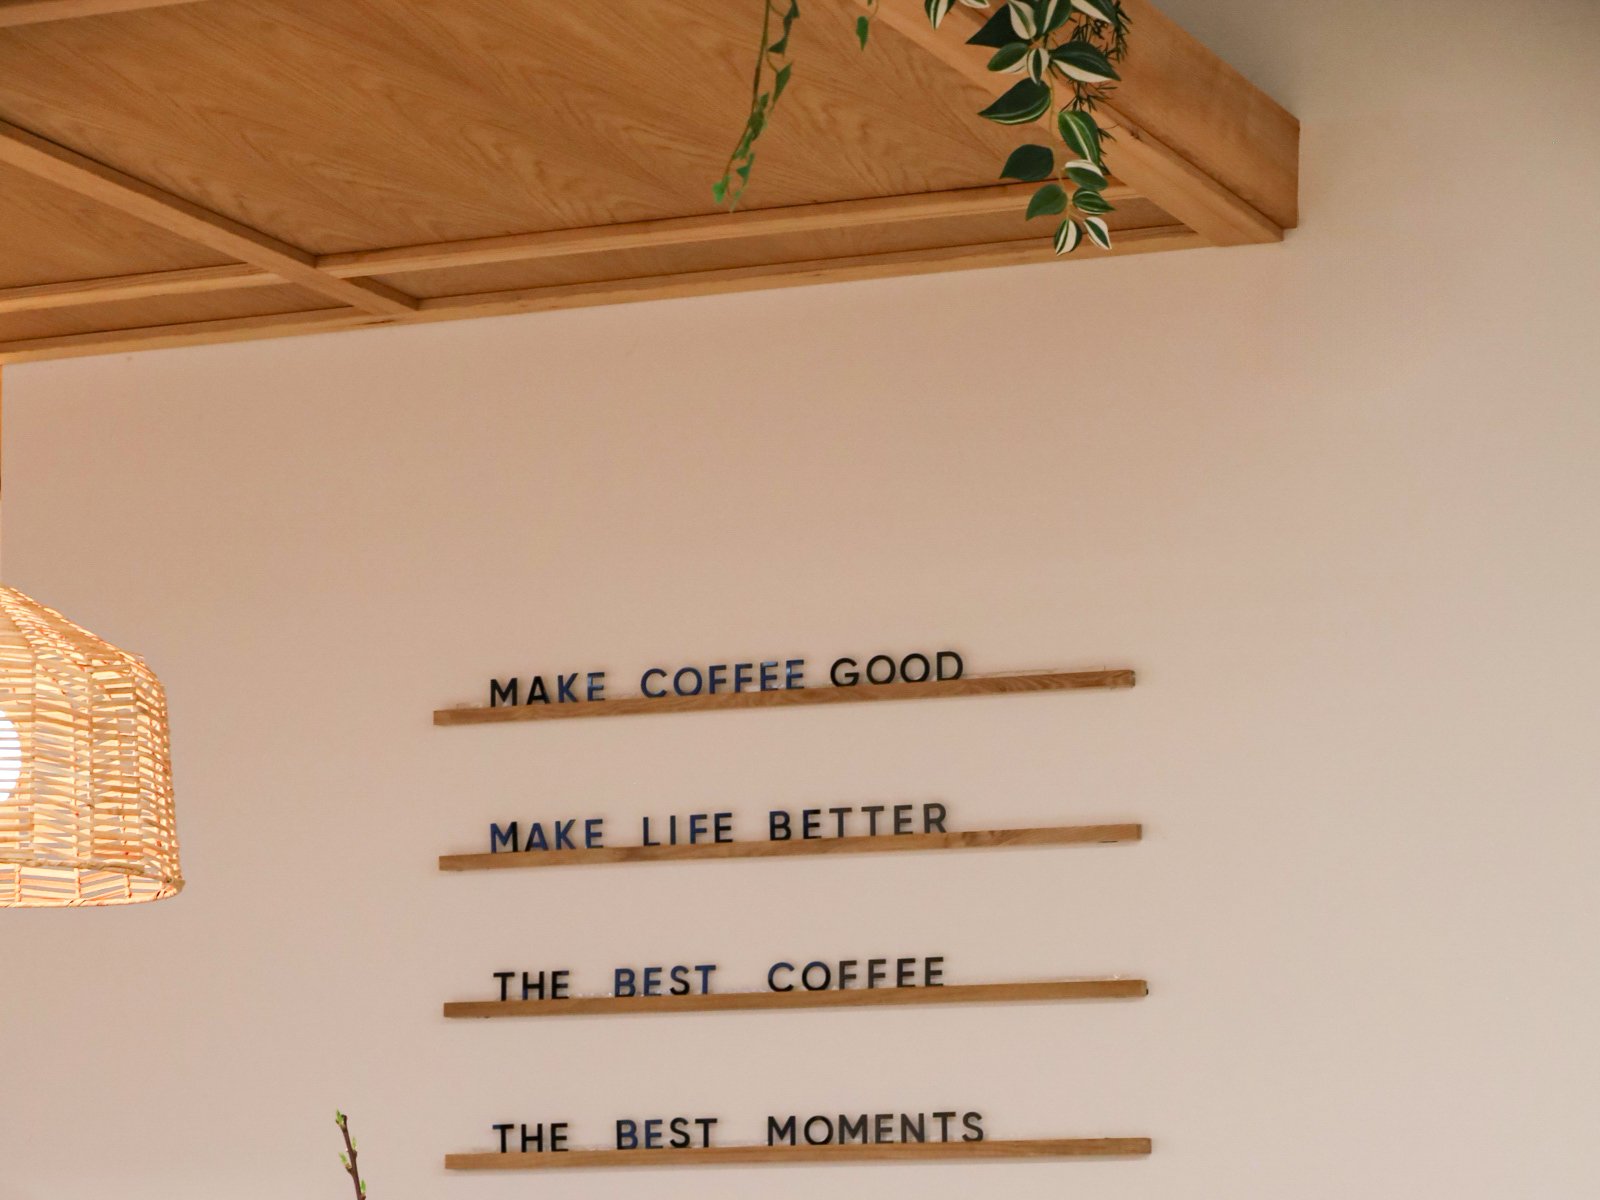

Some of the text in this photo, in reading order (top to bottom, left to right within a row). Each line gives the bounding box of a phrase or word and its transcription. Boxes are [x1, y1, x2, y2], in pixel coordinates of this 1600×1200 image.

[490, 650, 965, 709] MAKE COFFEE GOOD
[490, 802, 948, 854] MAKE LIFE BETTER
[493, 956, 944, 1003] THE BEST COFFEE
[492, 1111, 984, 1154] THE BEST MOMENTS
